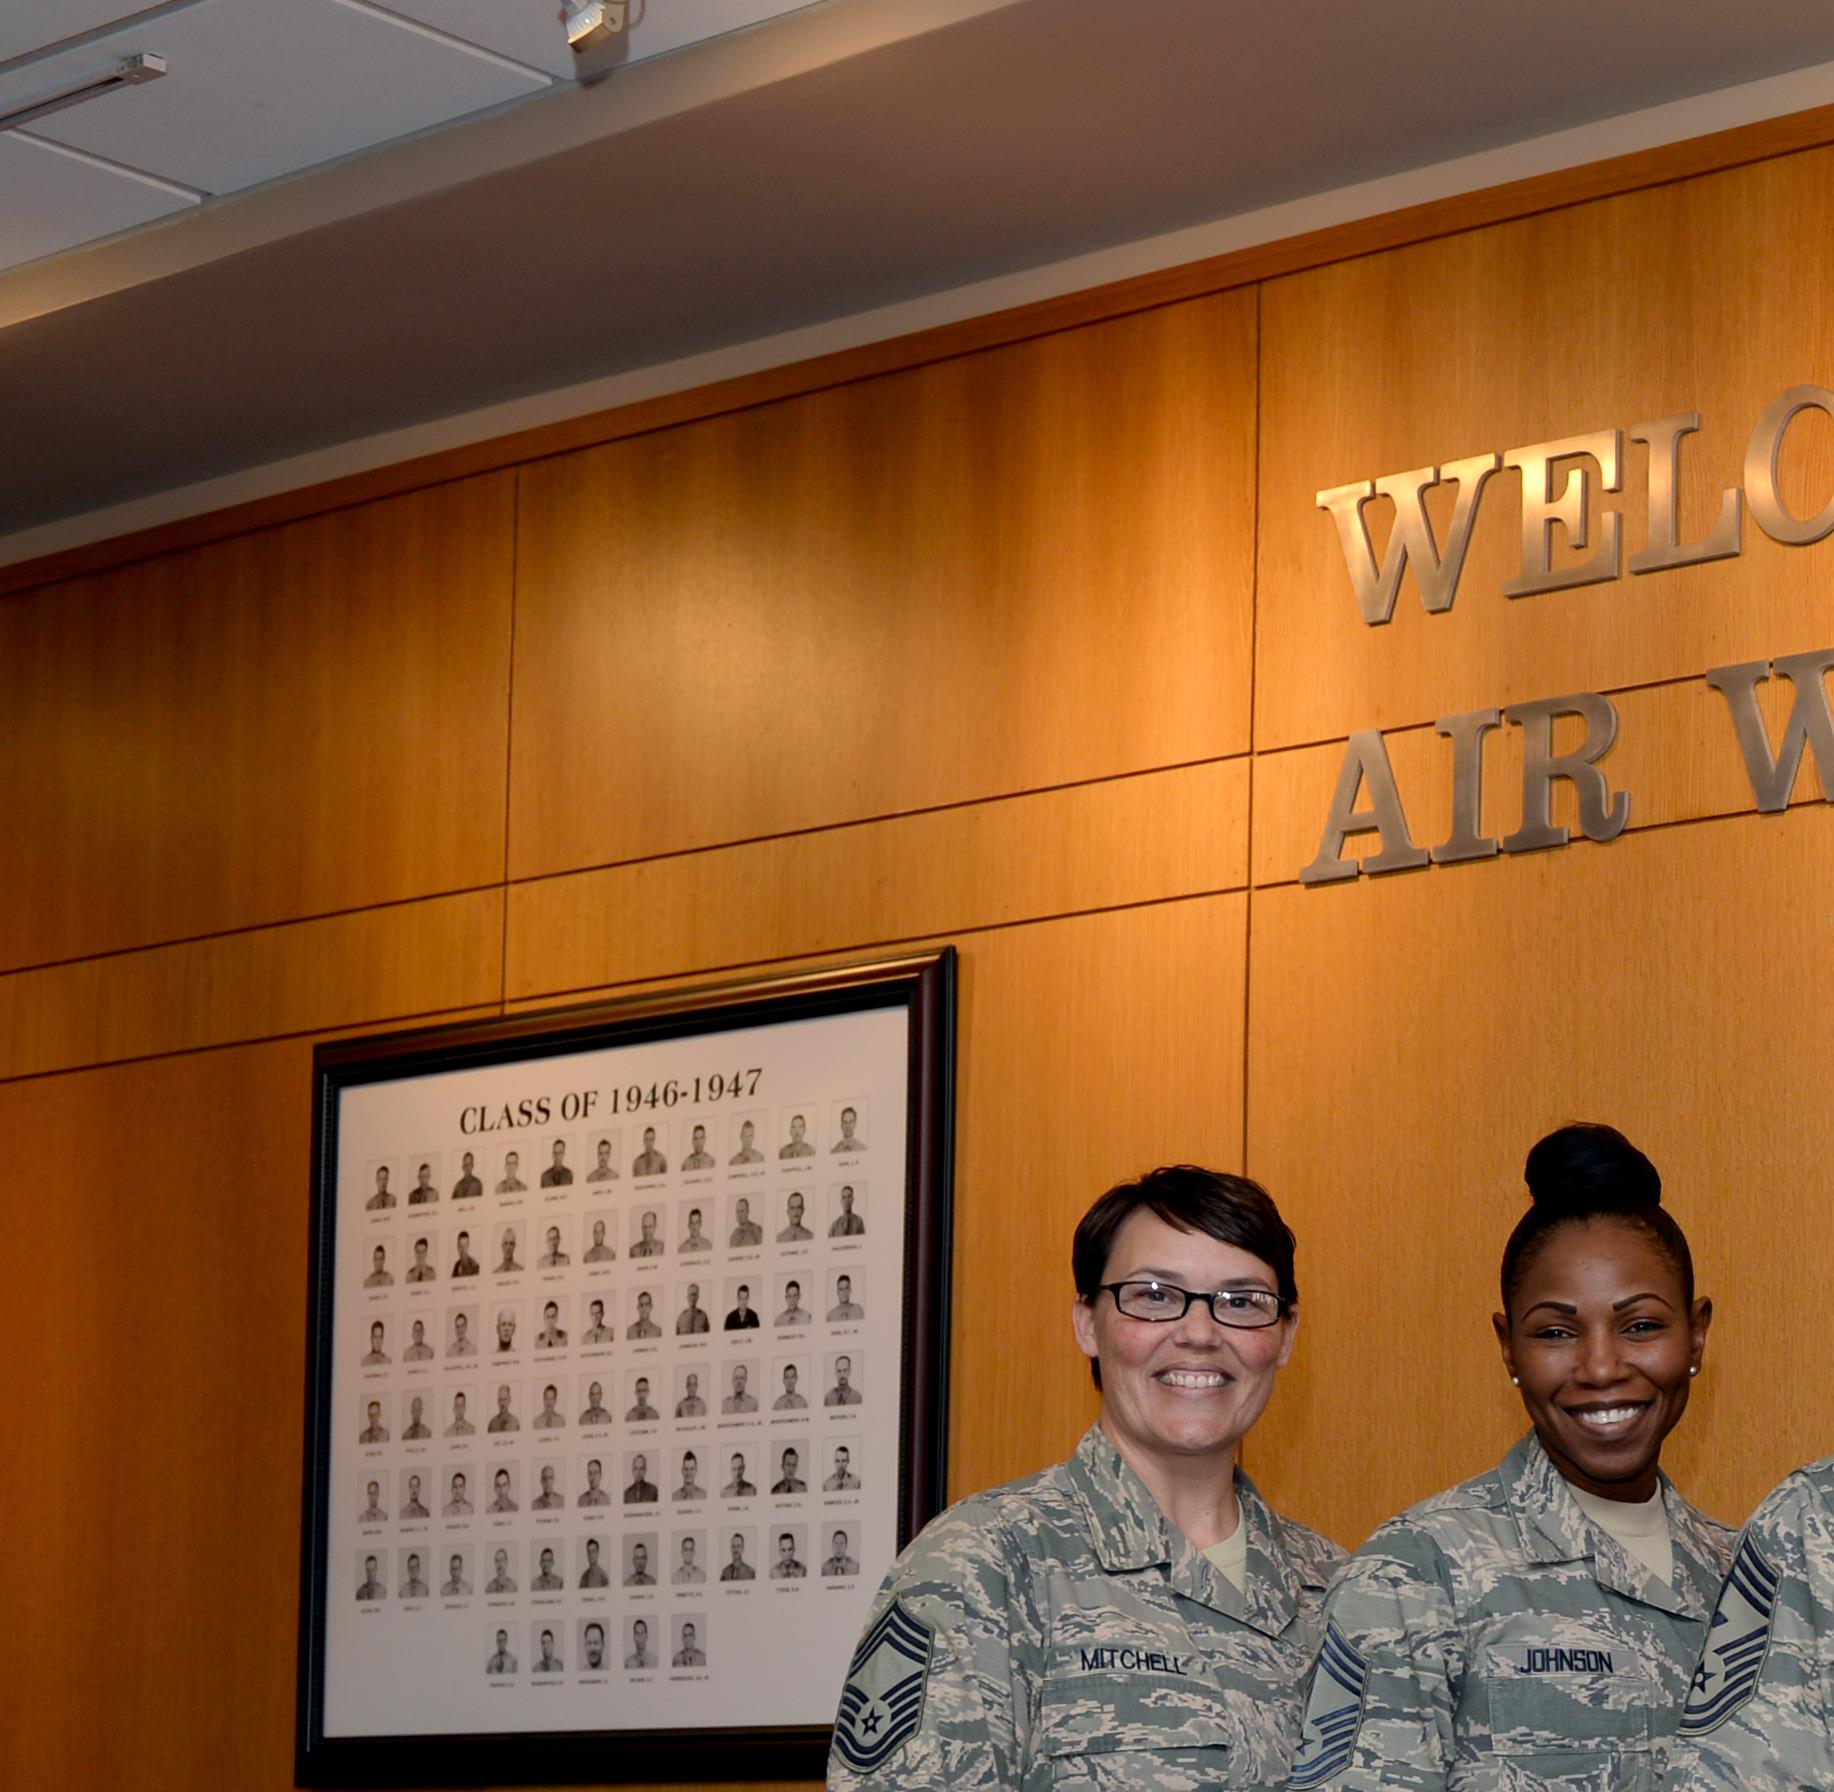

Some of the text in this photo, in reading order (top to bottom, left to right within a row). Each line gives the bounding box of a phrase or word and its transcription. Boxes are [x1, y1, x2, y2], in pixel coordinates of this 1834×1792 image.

[1299, 692, 1630, 886] AIR
[459, 1068, 764, 1135] CLASS OF 1946-1947
[1080, 1648, 1189, 1676] MITCHELL
[1519, 1648, 1614, 1675] JOHNSON
